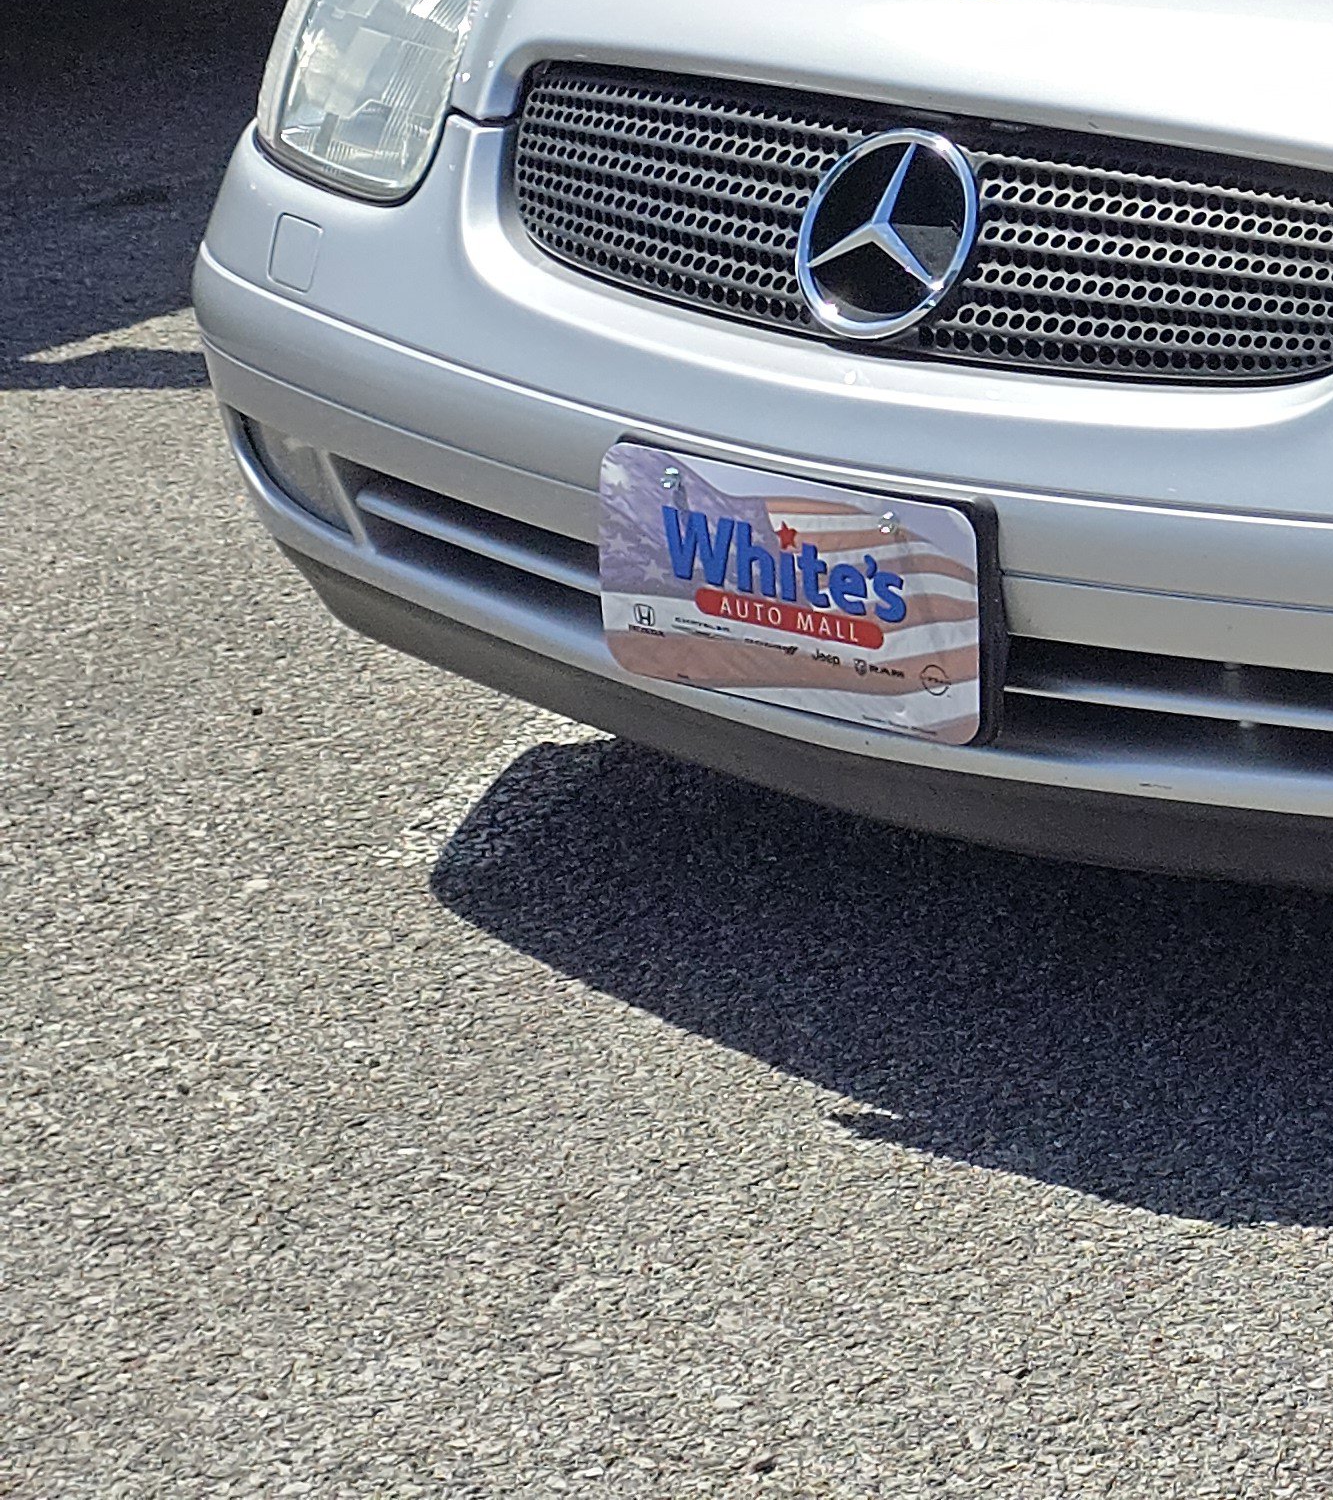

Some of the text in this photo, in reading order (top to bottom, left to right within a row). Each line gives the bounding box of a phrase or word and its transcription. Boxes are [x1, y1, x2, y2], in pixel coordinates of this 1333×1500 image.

[661, 505, 907, 623] White's
[719, 596, 860, 643] AUTO MALL
